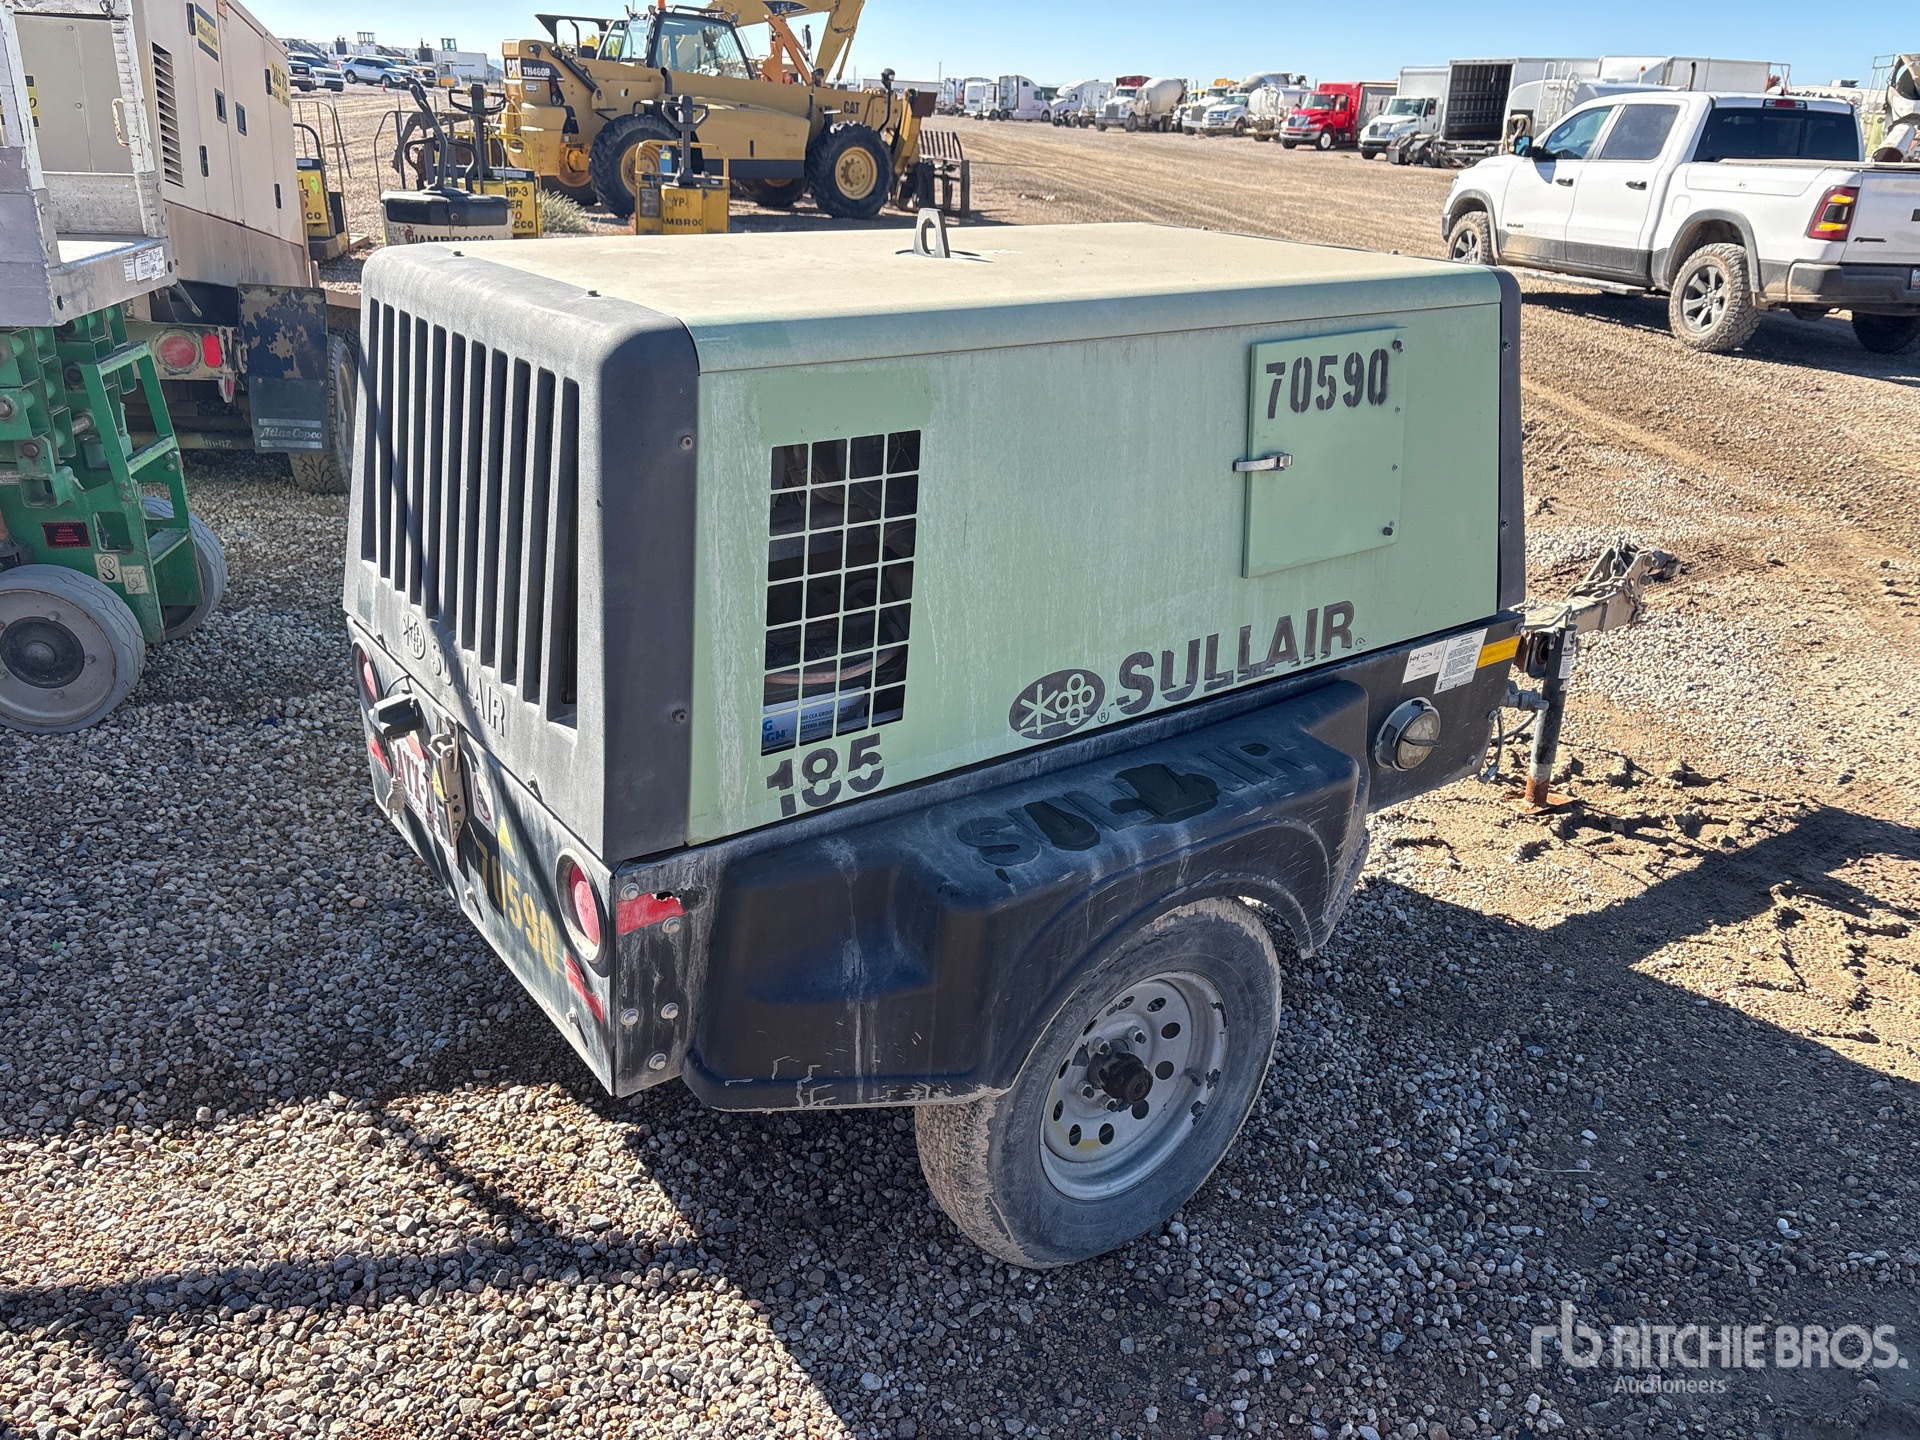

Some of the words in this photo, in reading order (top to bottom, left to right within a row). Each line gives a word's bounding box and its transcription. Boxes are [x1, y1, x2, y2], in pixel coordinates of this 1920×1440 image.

[843, 100, 861, 115] CAT
[1266, 348, 1389, 420] 70590
[1118, 600, 1355, 715] SULLAIR
[766, 732, 884, 817] 185
